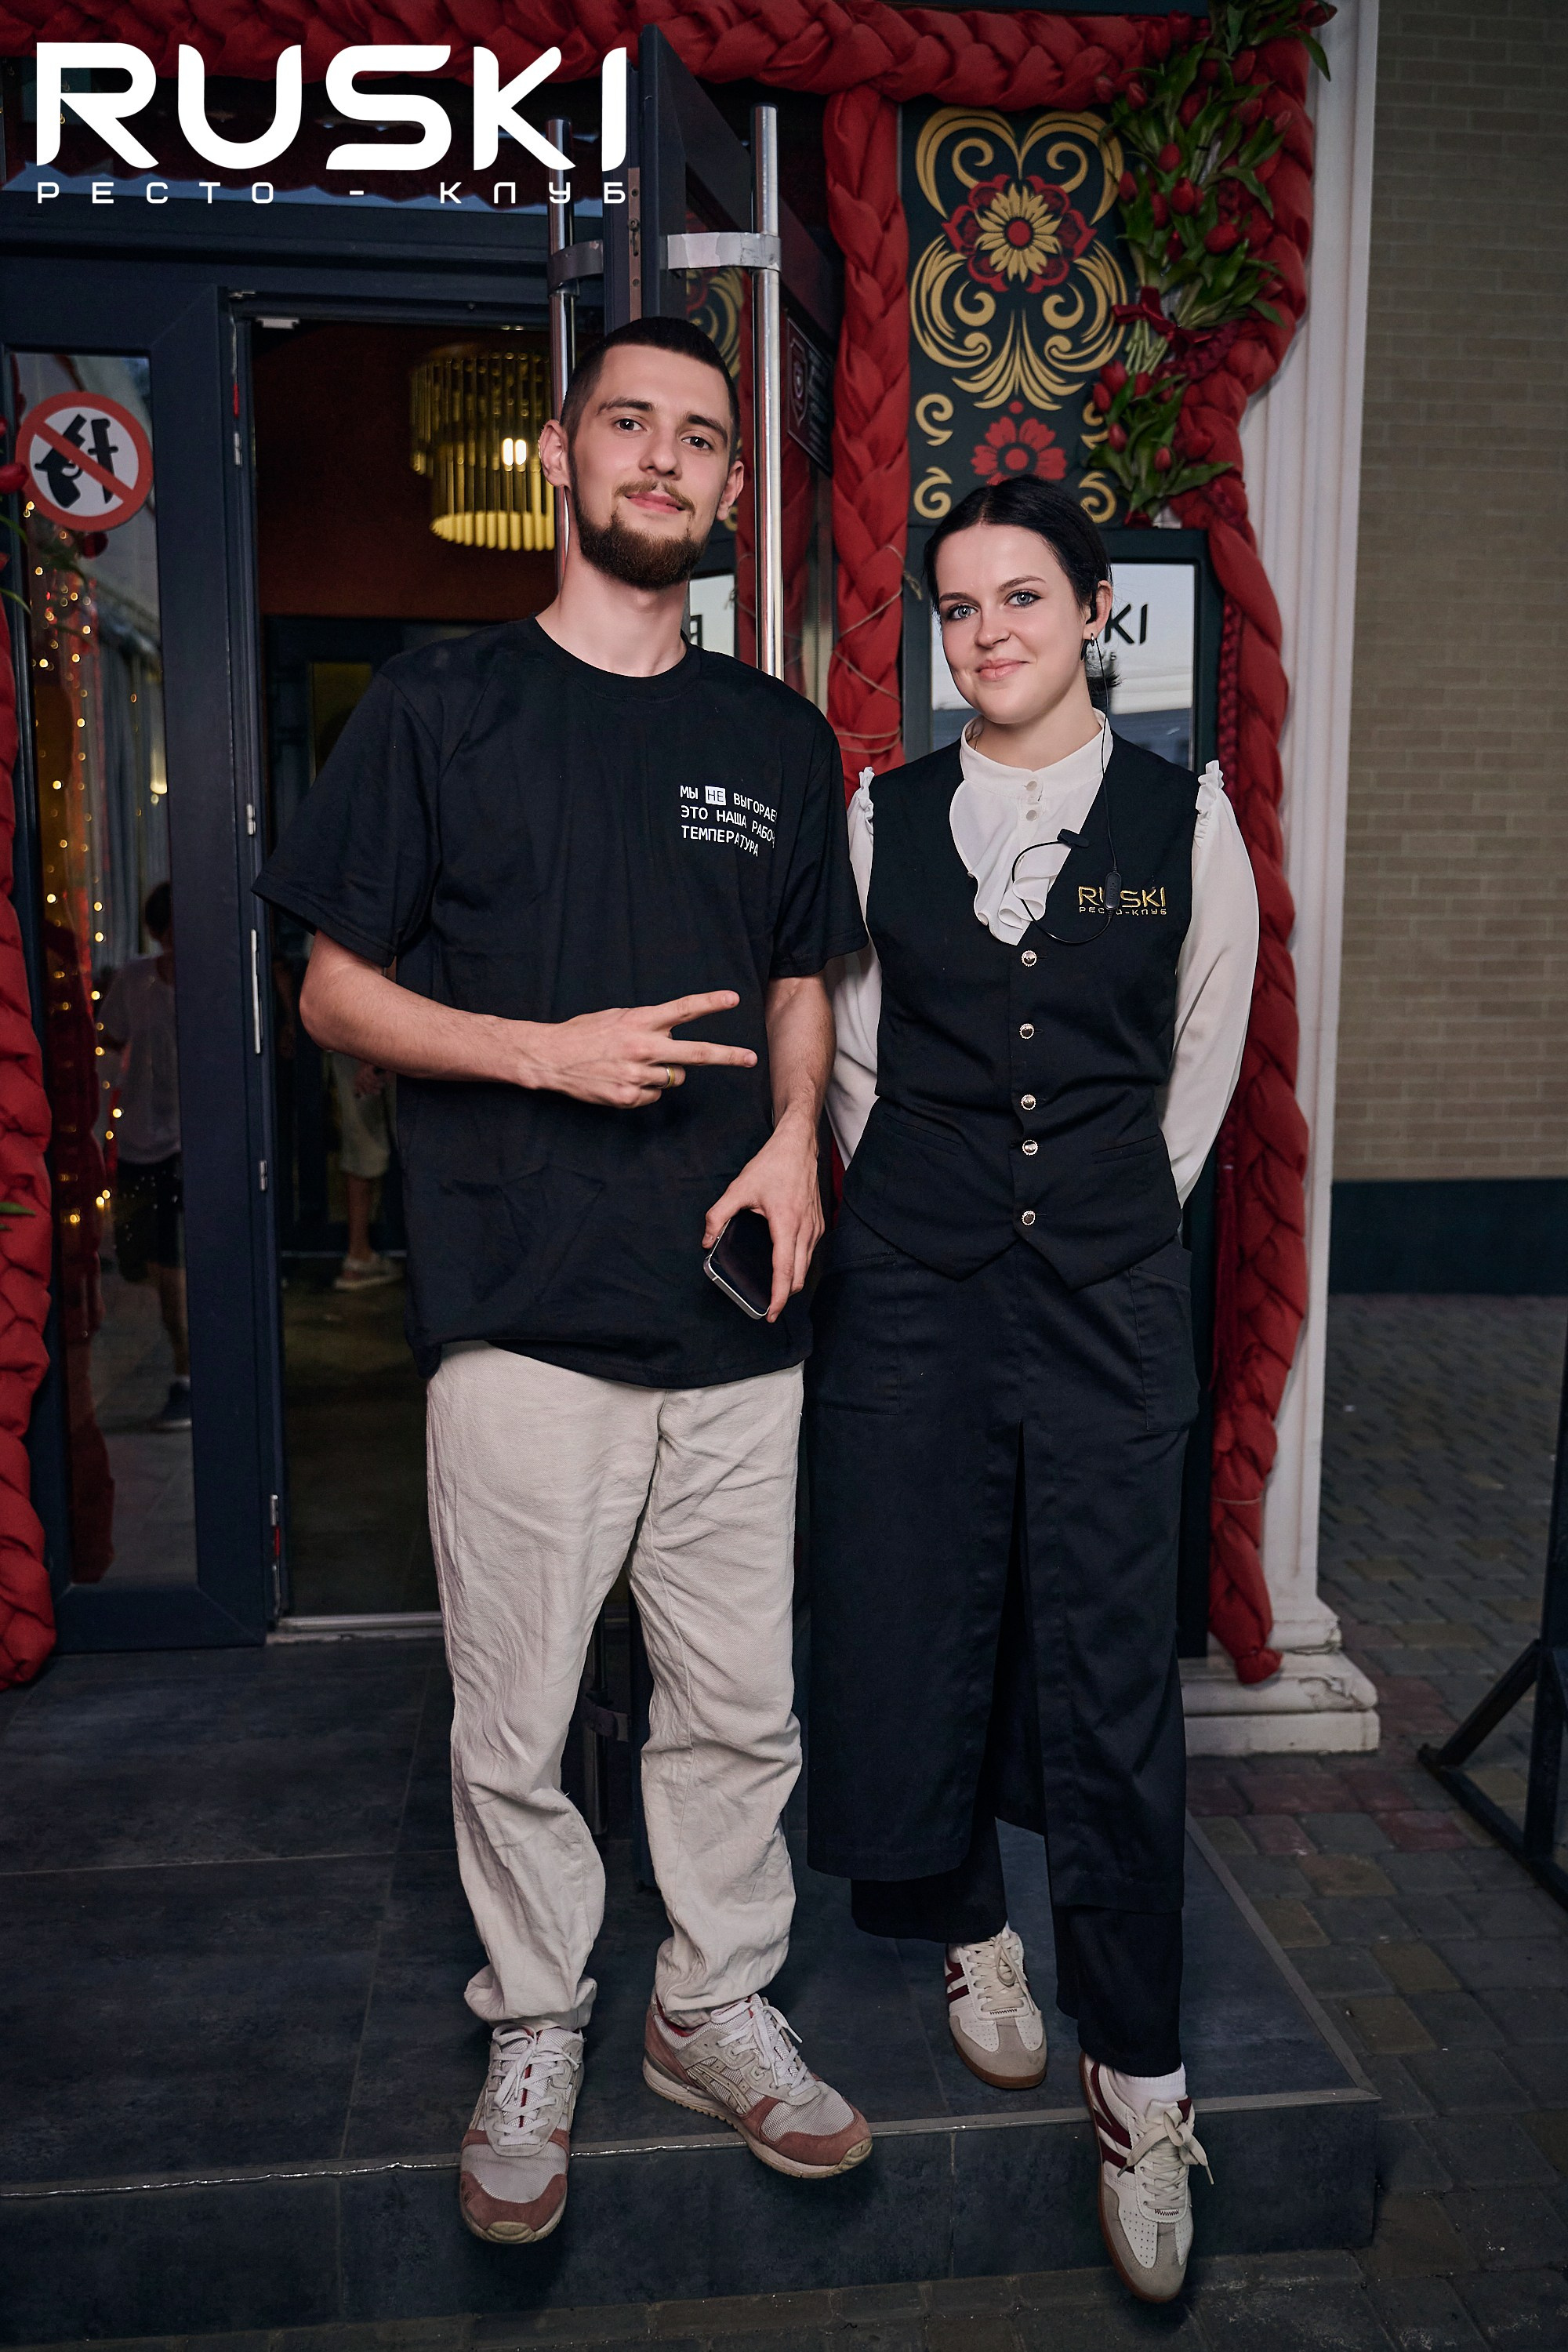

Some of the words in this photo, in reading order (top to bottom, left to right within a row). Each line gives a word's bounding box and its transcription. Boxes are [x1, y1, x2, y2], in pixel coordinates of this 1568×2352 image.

[680, 785, 699, 800] МЫ
[706, 786, 725, 804] НЕ
[733, 793, 778, 823] ВЫГОРАЕ
[681, 804, 709, 820] ЭТО
[716, 809, 747, 829] НАША
[681, 825, 759, 858] ТЕМПЕРАТУРА
[1079, 906, 1167, 916] РЕСО-КЛУБ
